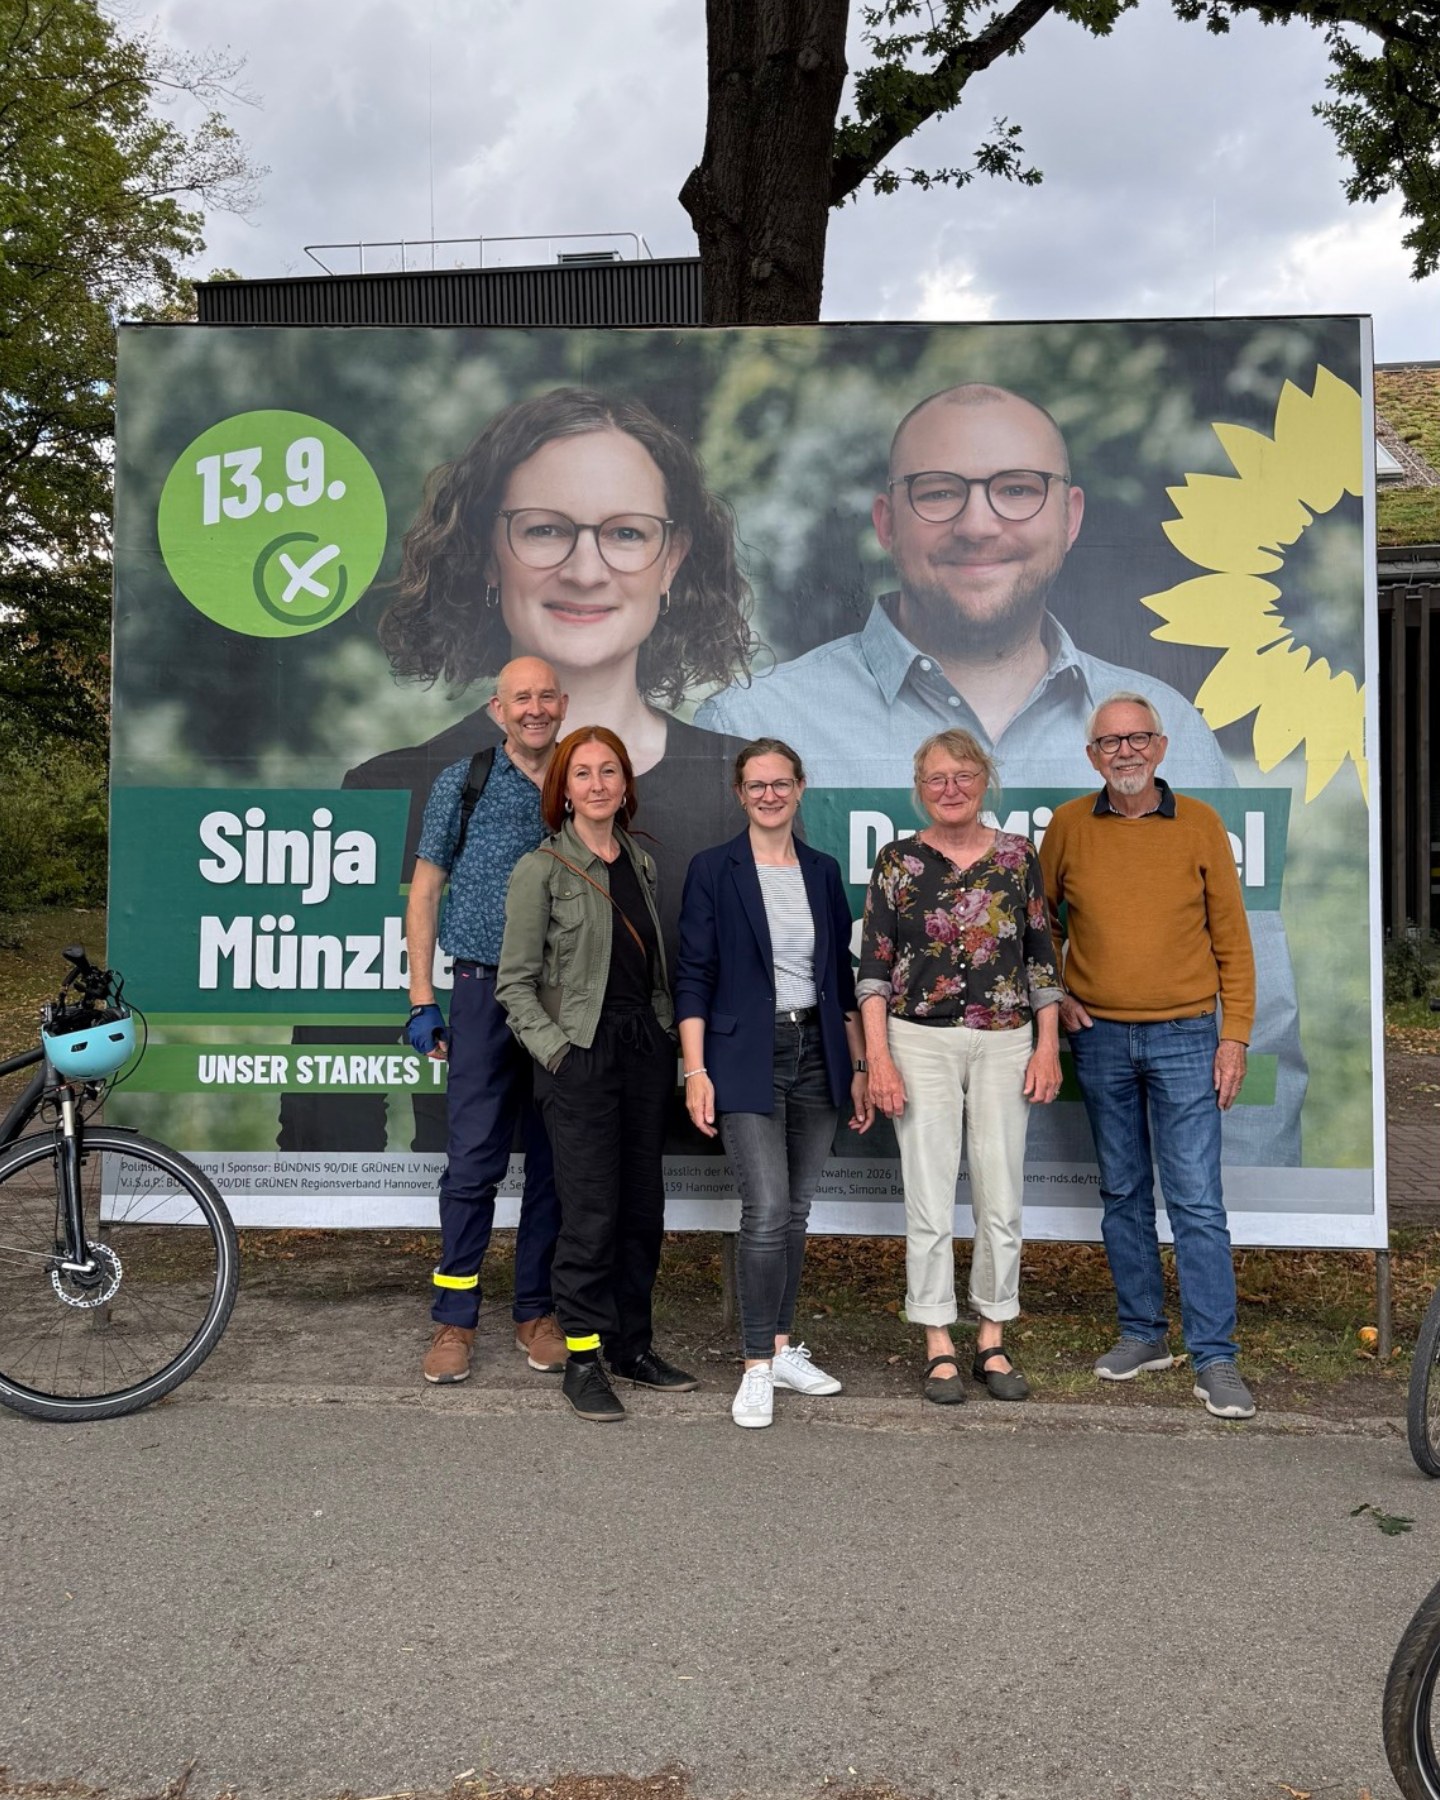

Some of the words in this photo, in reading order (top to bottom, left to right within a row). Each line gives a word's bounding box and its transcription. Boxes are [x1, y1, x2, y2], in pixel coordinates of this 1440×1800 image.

[196, 437, 347, 526] 13.9.
[199, 807, 377, 905] Sinja
[198, 1055, 289, 1084] UNSER
[296, 1055, 420, 1085] STARKES
[227, 1162, 271, 1174] Sponsor:
[274, 1161, 321, 1173] BÜNDNIS
[324, 1162, 358, 1174] 90/DIE
[361, 1161, 405, 1173] GRÜNEN
[408, 1163, 420, 1173] LV
[423, 1162, 446, 1173] Nied
[704, 1166, 721, 1177] der
[866, 1168, 892, 1179] 2026
[217, 1177, 251, 1189] 90/DIE
[254, 1176, 298, 1188] GRÜNEN
[301, 1178, 381, 1191] Regionsverband
[384, 1179, 435, 1190] Hannover,
[686, 1182, 734, 1192] Hannover
[849, 1184, 887, 1195] Simona
